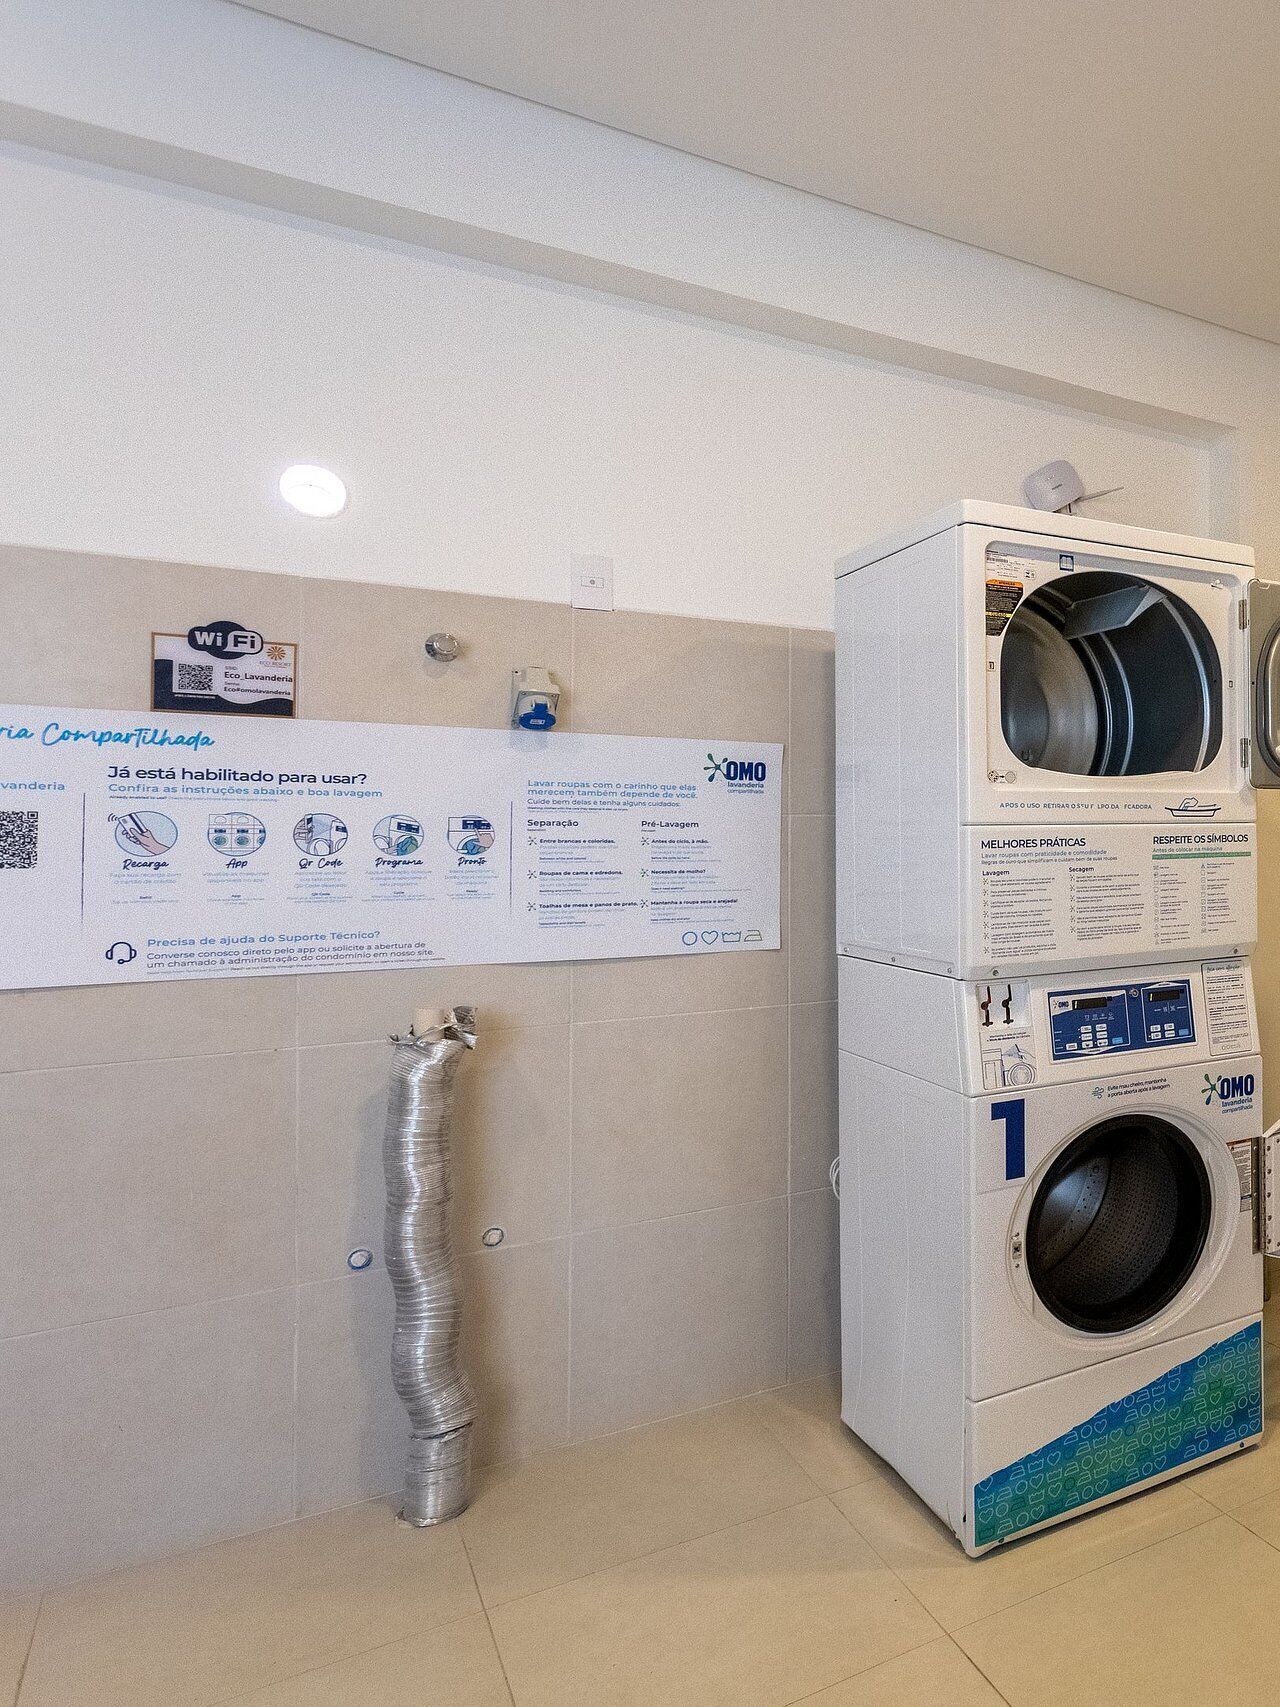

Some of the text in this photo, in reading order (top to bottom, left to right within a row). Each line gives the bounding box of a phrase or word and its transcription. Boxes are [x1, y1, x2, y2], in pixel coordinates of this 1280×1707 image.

[224, 671, 293, 683] Eco_Lavanderia
[41, 723, 215, 751] Compartilhada
[108, 766, 367, 785] Já está habilitado para usar?
[725, 761, 766, 781] OMO
[109, 784, 159, 793] Confira
[182, 785, 249, 796] instruções
[253, 787, 294, 796] abaixo
[308, 788, 330, 796] boa
[333, 789, 382, 799] lavagem
[527, 780, 554, 788] Lavar
[556, 781, 590, 789] roupas
[623, 782, 658, 790] carinho
[660, 784, 677, 793] que
[679, 783, 697, 791] elas
[577, 789, 618, 797] também
[620, 790, 661, 799] depende
[662, 791, 674, 799] de
[622, 800, 646, 808] alguns
[527, 819, 579, 828] Separação
[641, 820, 699, 829] Pré-Lavagem
[981, 836, 1086, 849] MELHORES PRÁTICAS
[1153, 833, 1248, 844] RESPEITE OS SÍMBOLOS
[1035, 850, 1067, 858] praticidade
[123, 858, 169, 870] Recarga
[225, 858, 248, 869] App
[299, 858, 343, 869] Qr Code
[375, 858, 424, 868] Programa
[458, 857, 487, 867] Pronto
[147, 931, 380, 947] Precisa de ajuda do Suporte Técnico?
[146, 951, 195, 960] Converse
[198, 949, 240, 958] conosco
[242, 948, 271, 956] direto
[274, 947, 295, 955] pelo
[297, 946, 316, 954] app
[332, 943, 365, 952] solicite
[374, 942, 412, 950] abertura
[415, 941, 426, 949] de
[167, 959, 217, 968] chamado
[228, 955, 298, 965] administração
[315, 952, 371, 961] condomínio
[1220, 1074, 1255, 1100] OMO
[1222, 1097, 1253, 1107] lavanderia
[991, 1098, 1025, 1181] 1
